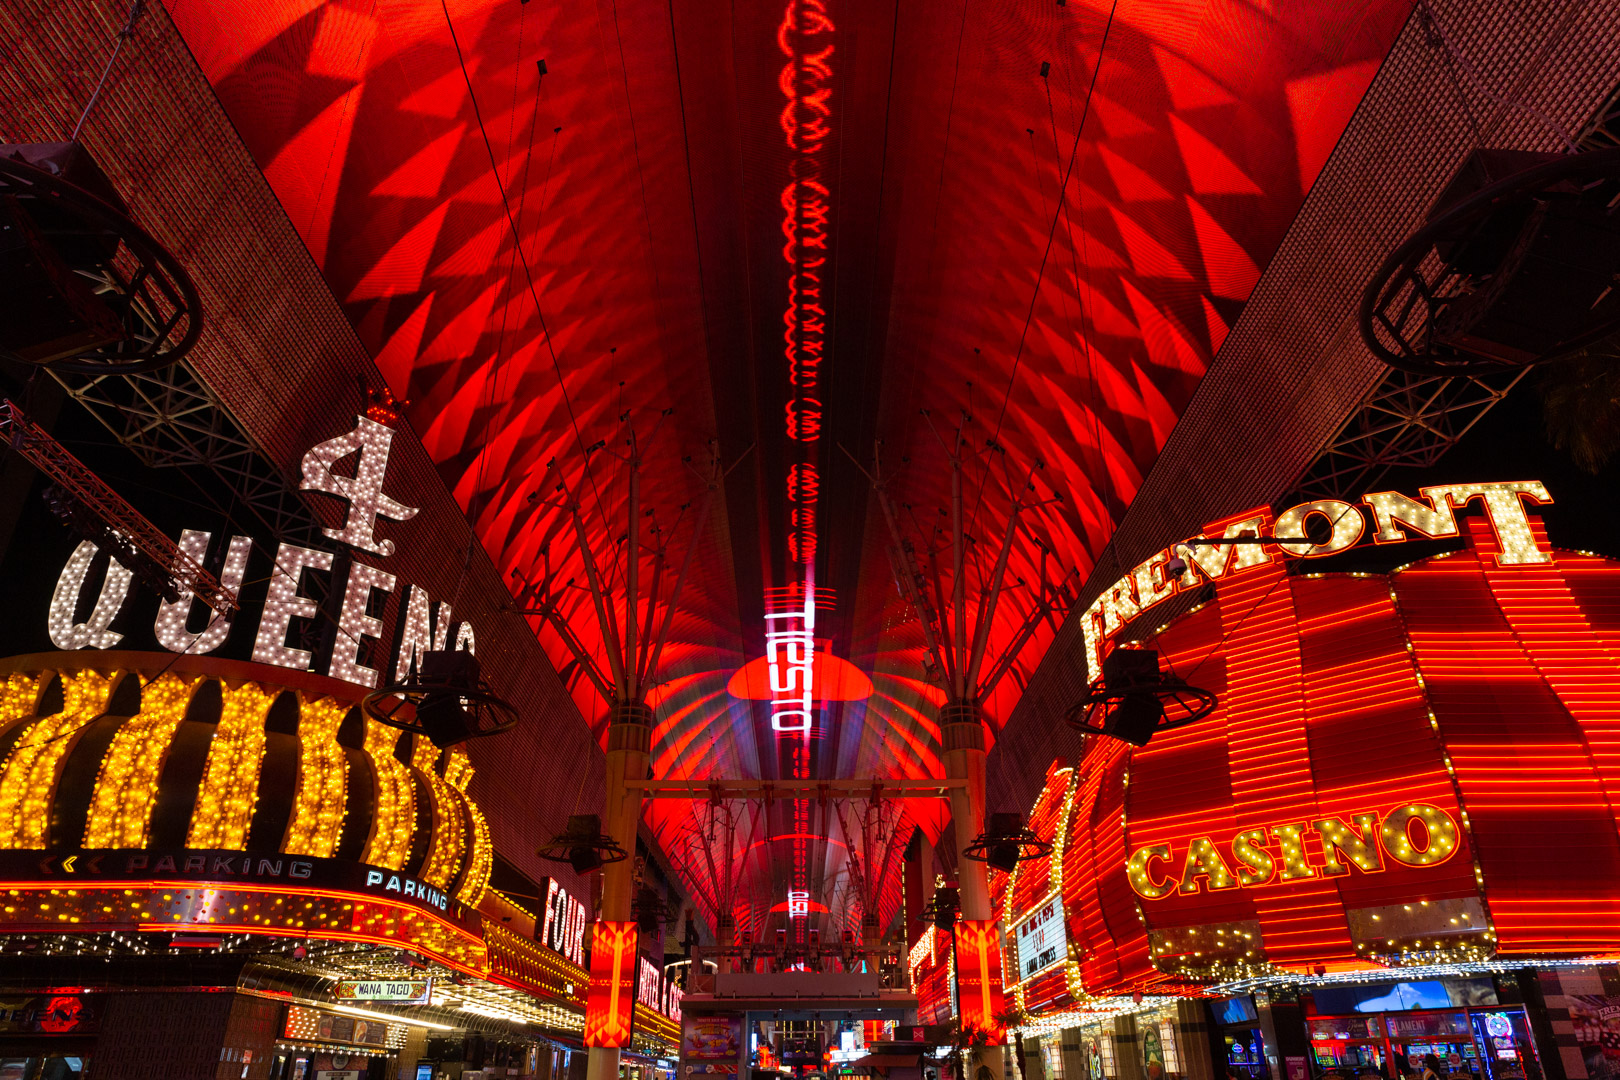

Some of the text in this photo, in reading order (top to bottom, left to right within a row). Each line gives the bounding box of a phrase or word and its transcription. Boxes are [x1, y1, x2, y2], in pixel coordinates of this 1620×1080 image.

[299, 415, 420, 556] 4
[1080, 479, 1555, 683] FREMONT
[125, 854, 313, 879] PARKING
[1126, 803, 1461, 901] CASINO
[366, 870, 448, 911] PARKING
[542, 877, 586, 967] FOUR
[358, 983, 409, 995] WANA TACO
[637, 956, 659, 1012] HOTEL
